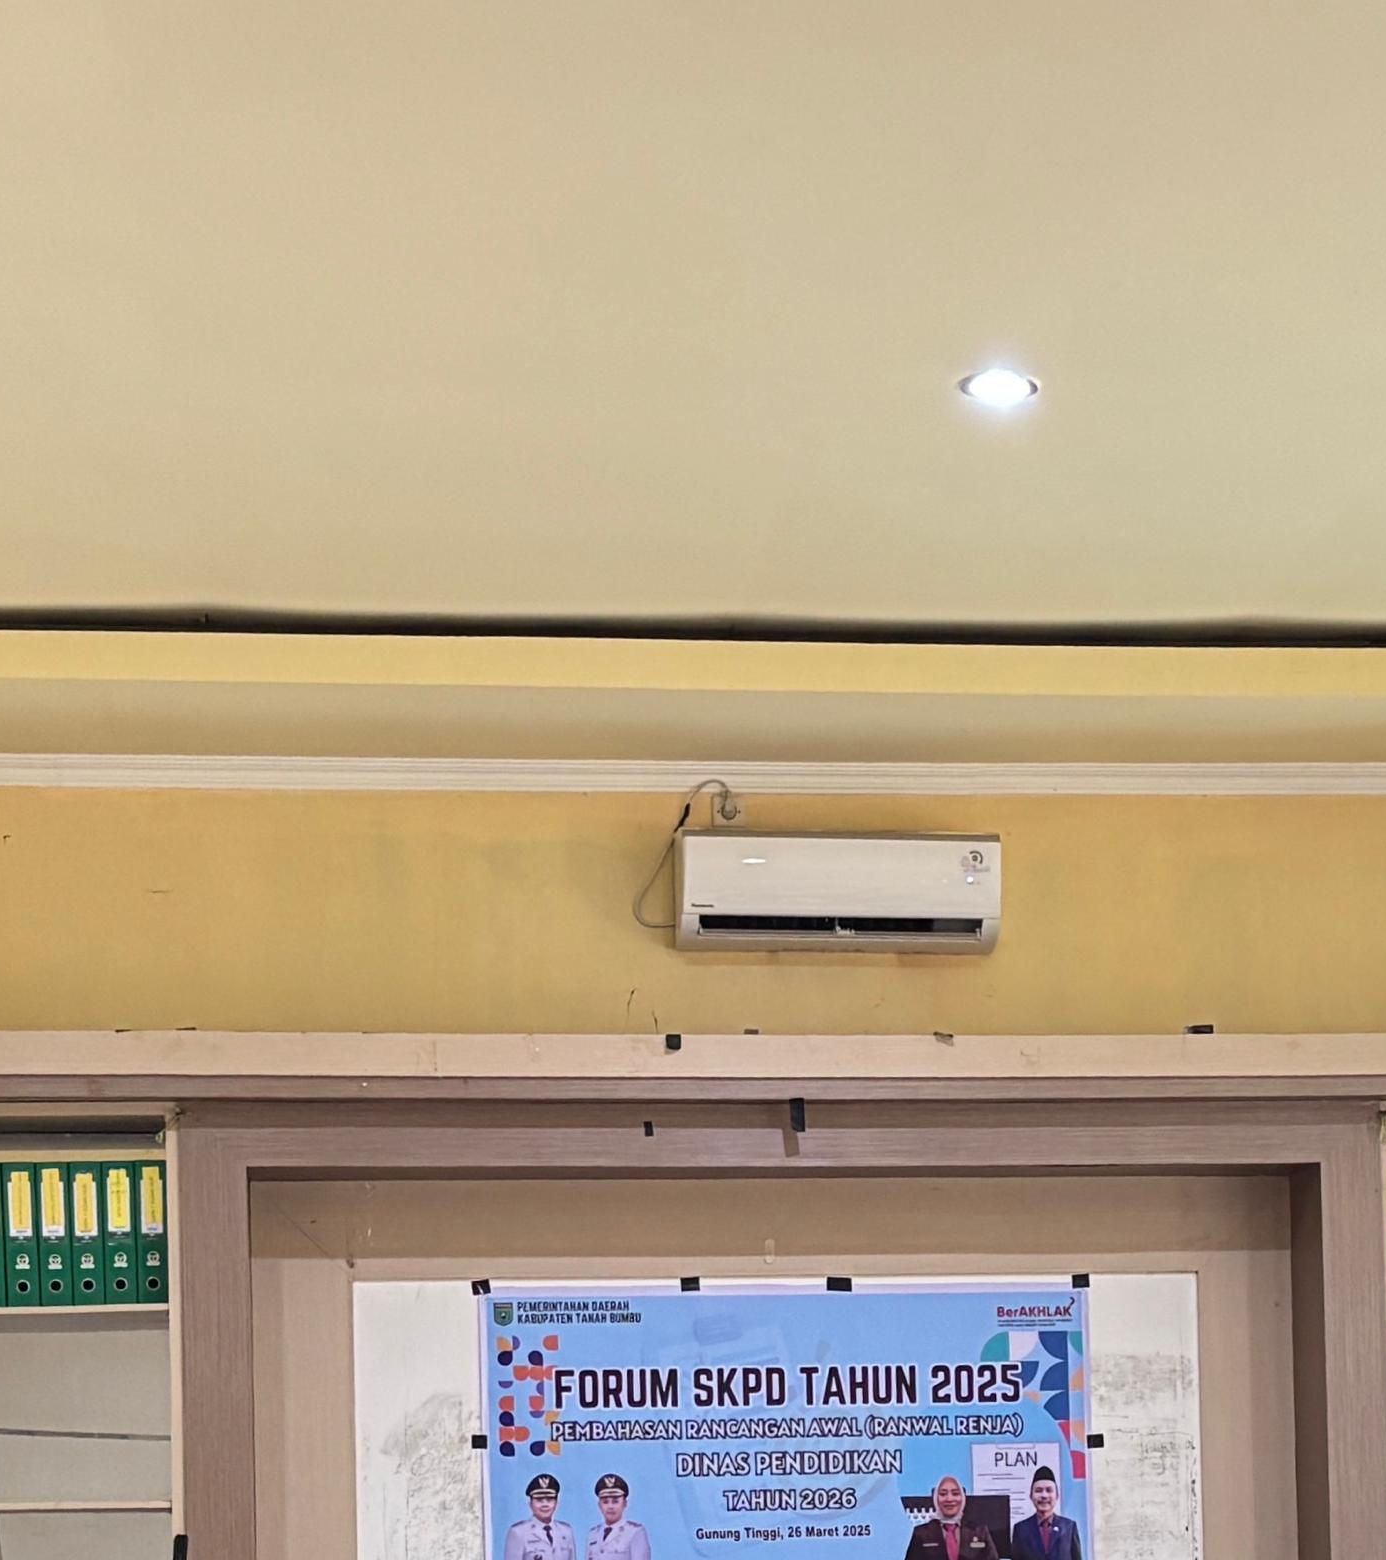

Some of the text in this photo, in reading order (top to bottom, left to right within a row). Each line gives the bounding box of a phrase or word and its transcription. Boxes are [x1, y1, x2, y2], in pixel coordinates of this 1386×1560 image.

[517, 1301, 630, 1312] PEMERINTAHAN DAERAH
[996, 1306, 1072, 1318] BerAKHLAK
[517, 1312, 642, 1324] KABUPATEN TANAH BUMBU
[554, 1363, 1021, 1409] FORUM SKPD TAHUN 2025
[551, 1412, 1024, 1441] PEMBAHASAN RANCANGAN AWAL (RANWAL RENJA)
[676, 1449, 903, 1477] DINAS PENDIDIKAN
[994, 1452, 1037, 1467] PLAN
[723, 1488, 857, 1511] TAHUN 2026
[696, 1525, 871, 1541] Gunung Tinggi, 26 Maret 2025
